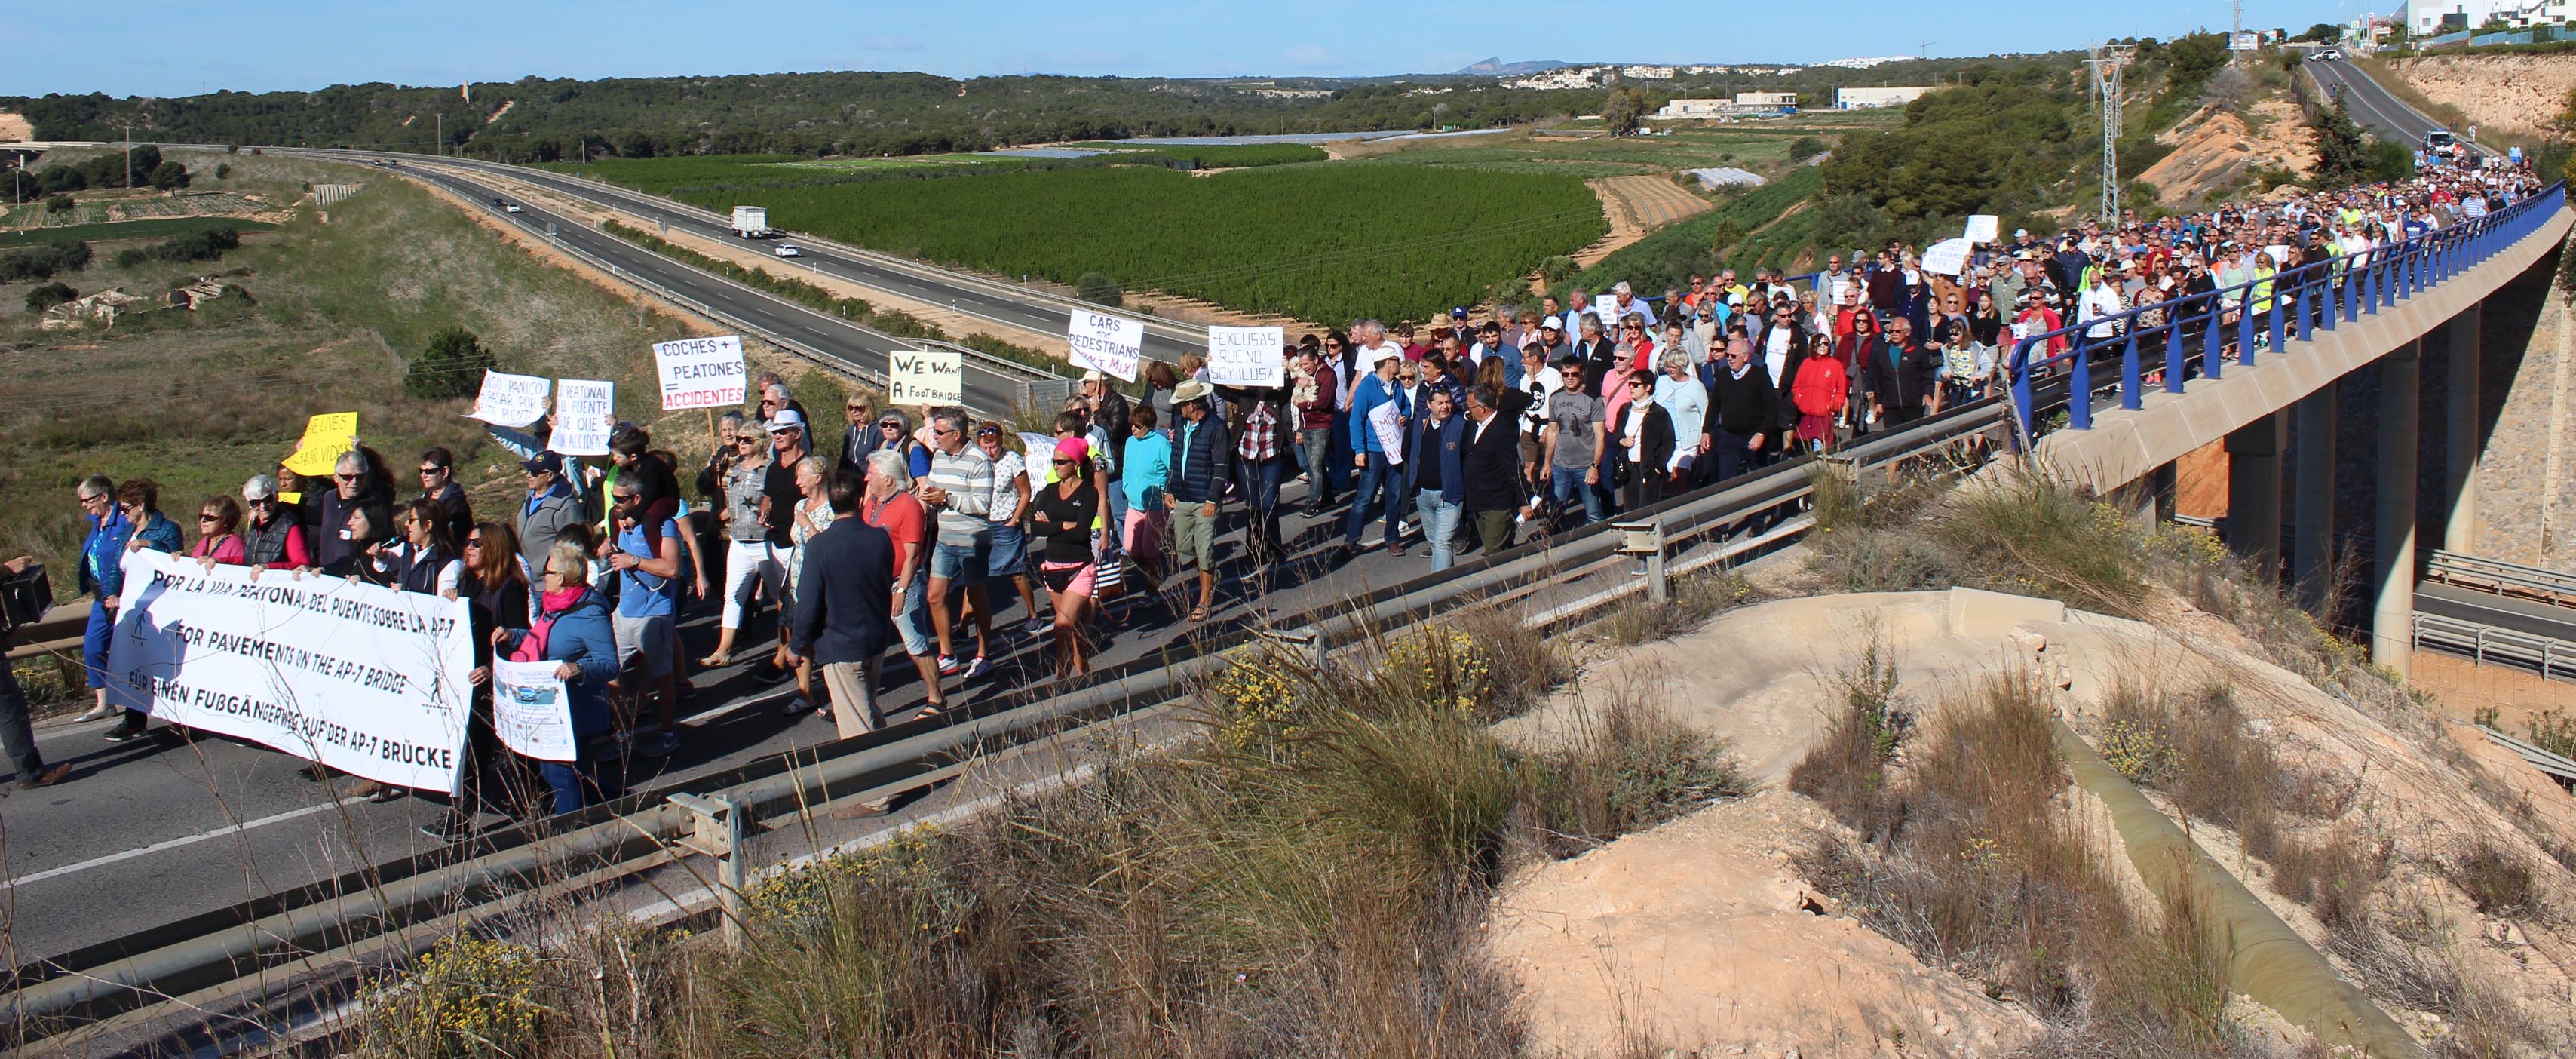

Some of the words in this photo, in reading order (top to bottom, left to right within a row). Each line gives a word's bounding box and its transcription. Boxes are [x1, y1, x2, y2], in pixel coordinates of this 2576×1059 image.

[1090, 315, 1121, 332] CARS
[1096, 330, 1111, 339] and
[663, 339, 717, 357] COCHES
[1069, 333, 1139, 359] PEDESTRIANS
[894, 355, 924, 375] WE
[1079, 351, 1106, 367] ON'T
[1245, 350, 1262, 364] NO
[673, 361, 744, 379] PEATONES
[1211, 367, 1234, 380] SOY
[1238, 367, 1274, 381] ILUSA
[665, 388, 744, 407] ACCIDENTES
[893, 381, 903, 398] A
[572, 401, 608, 415] PUENTE
[578, 417, 598, 431] QUE
[152, 569, 186, 590] POR
[186, 578, 205, 594] LA
[232, 584, 308, 609] PEATONAL
[308, 593, 327, 613] DEL
[331, 597, 372, 624] PUENTE
[373, 607, 406, 631] SOBRE
[409, 614, 425, 635] LA
[431, 617, 455, 639] AP-7
[176, 625, 204, 646] FOR
[208, 631, 296, 665] PAVEMENTS
[296, 649, 311, 670] ON
[312, 653, 336, 676] THE
[333, 660, 364, 683] AP-7
[364, 667, 408, 695] BRIDGE
[128, 670, 149, 692] FÜR
[151, 677, 190, 703] EINEN
[302, 717, 326, 738] AUF
[327, 720, 347, 747] DER
[350, 730, 378, 756] AP-7
[382, 738, 452, 769] BRÜCKE
